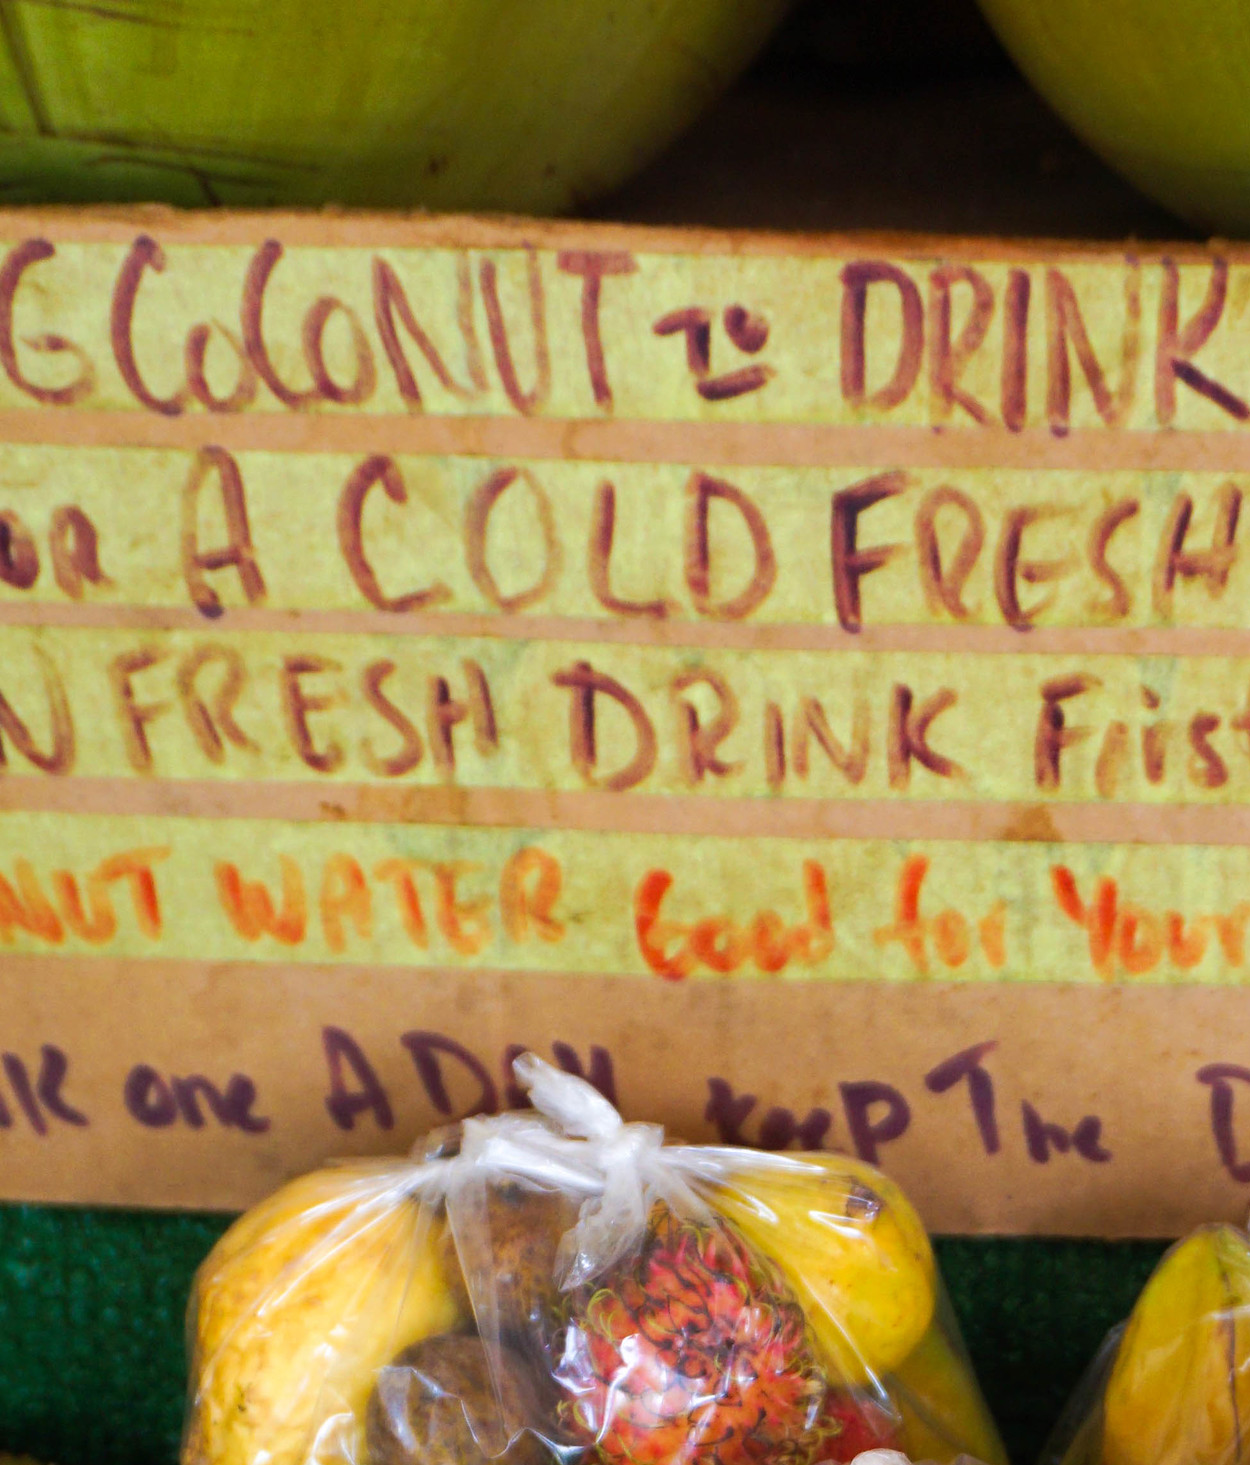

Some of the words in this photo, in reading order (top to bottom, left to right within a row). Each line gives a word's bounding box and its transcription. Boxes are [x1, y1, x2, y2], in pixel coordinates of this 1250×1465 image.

[182, 445, 268, 618] A
[336, 454, 777, 621] COLD
[830, 470, 1244, 634] FRESH
[108, 645, 500, 784] FRESH
[551, 659, 970, 792] DRINK
[214, 847, 568, 954] WATER
[123, 1063, 270, 1136] one
[924, 1039, 1112, 1165] The
